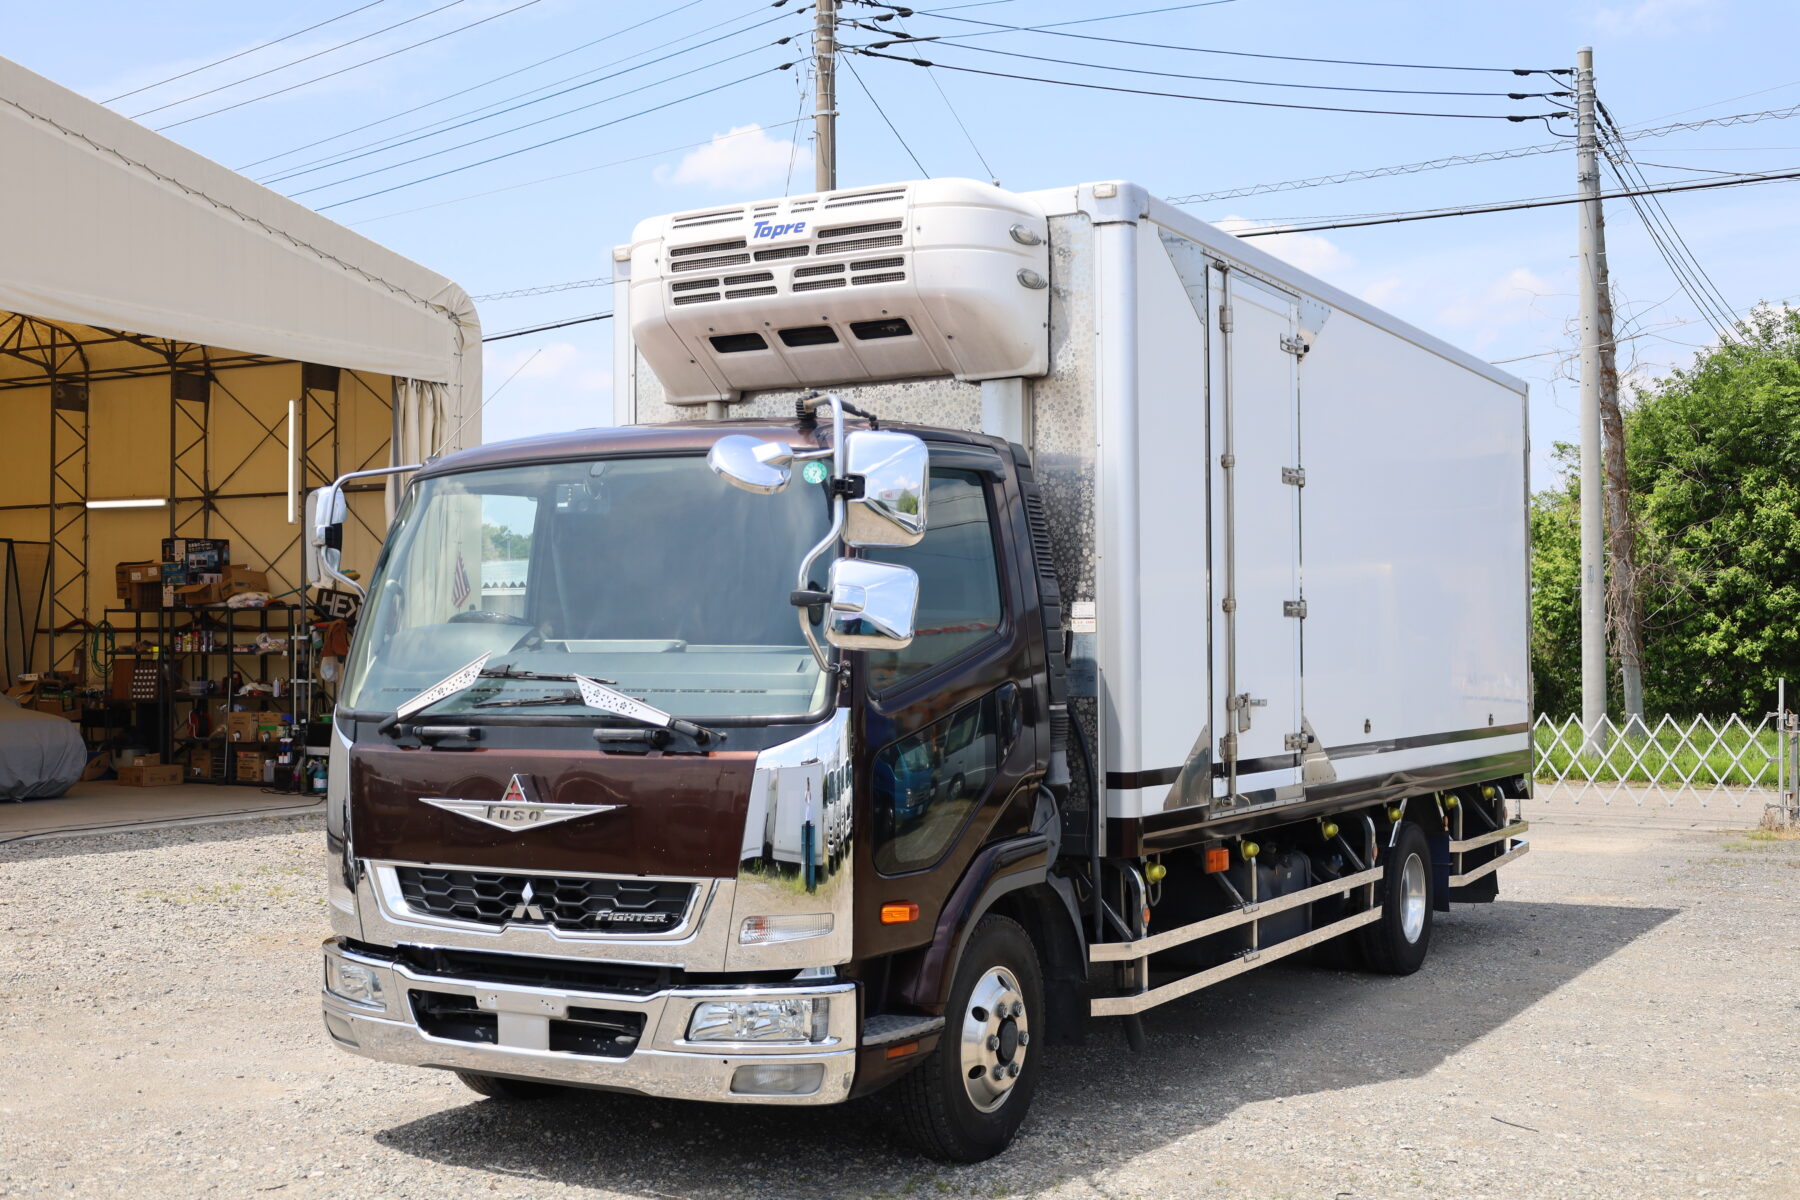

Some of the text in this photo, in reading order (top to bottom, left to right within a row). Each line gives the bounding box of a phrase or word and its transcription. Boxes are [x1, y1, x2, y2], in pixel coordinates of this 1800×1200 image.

[753, 220, 806, 240] Topre
[486, 804, 541, 822] FUSO
[595, 910, 667, 923] FIGHTER
